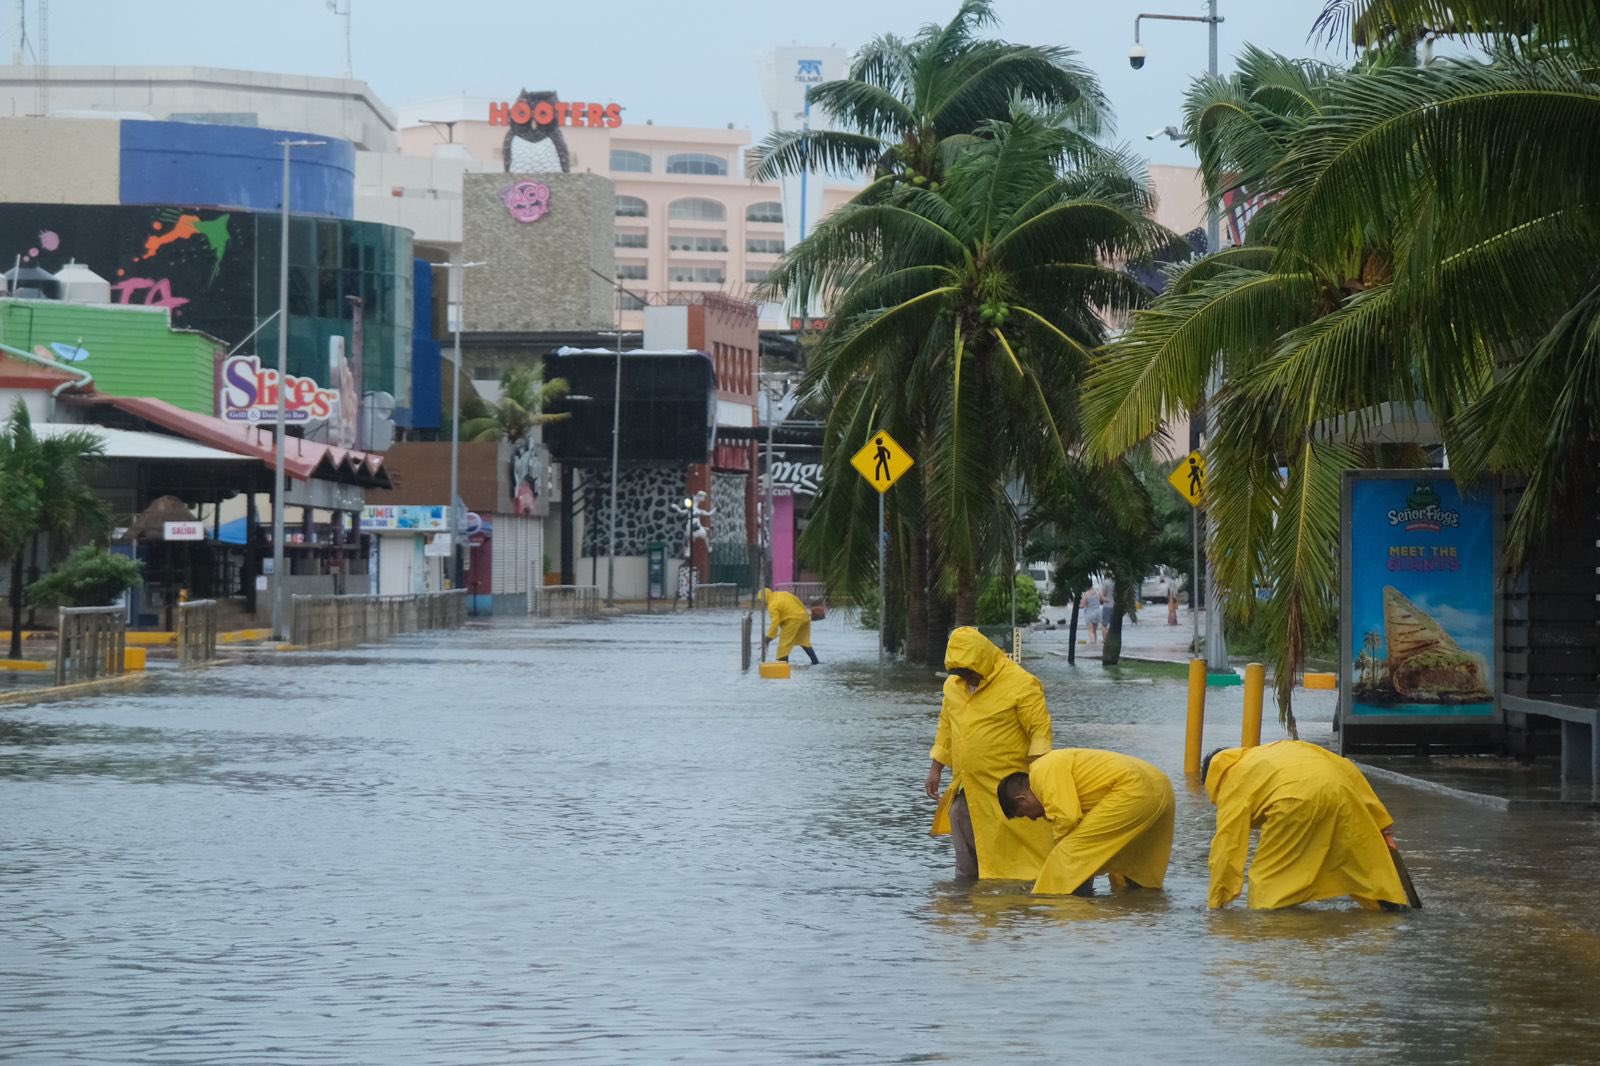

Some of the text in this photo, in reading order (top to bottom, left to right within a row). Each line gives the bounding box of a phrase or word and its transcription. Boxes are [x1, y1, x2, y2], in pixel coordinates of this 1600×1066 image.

[489, 101, 622, 128] HOOTERS
[226, 359, 331, 417] Slices
[1387, 508, 1425, 525] Señor
[171, 527, 196, 535] SALIDA
[1389, 547, 1457, 557] MEET THE
[1387, 558, 1459, 572] GIANTS
